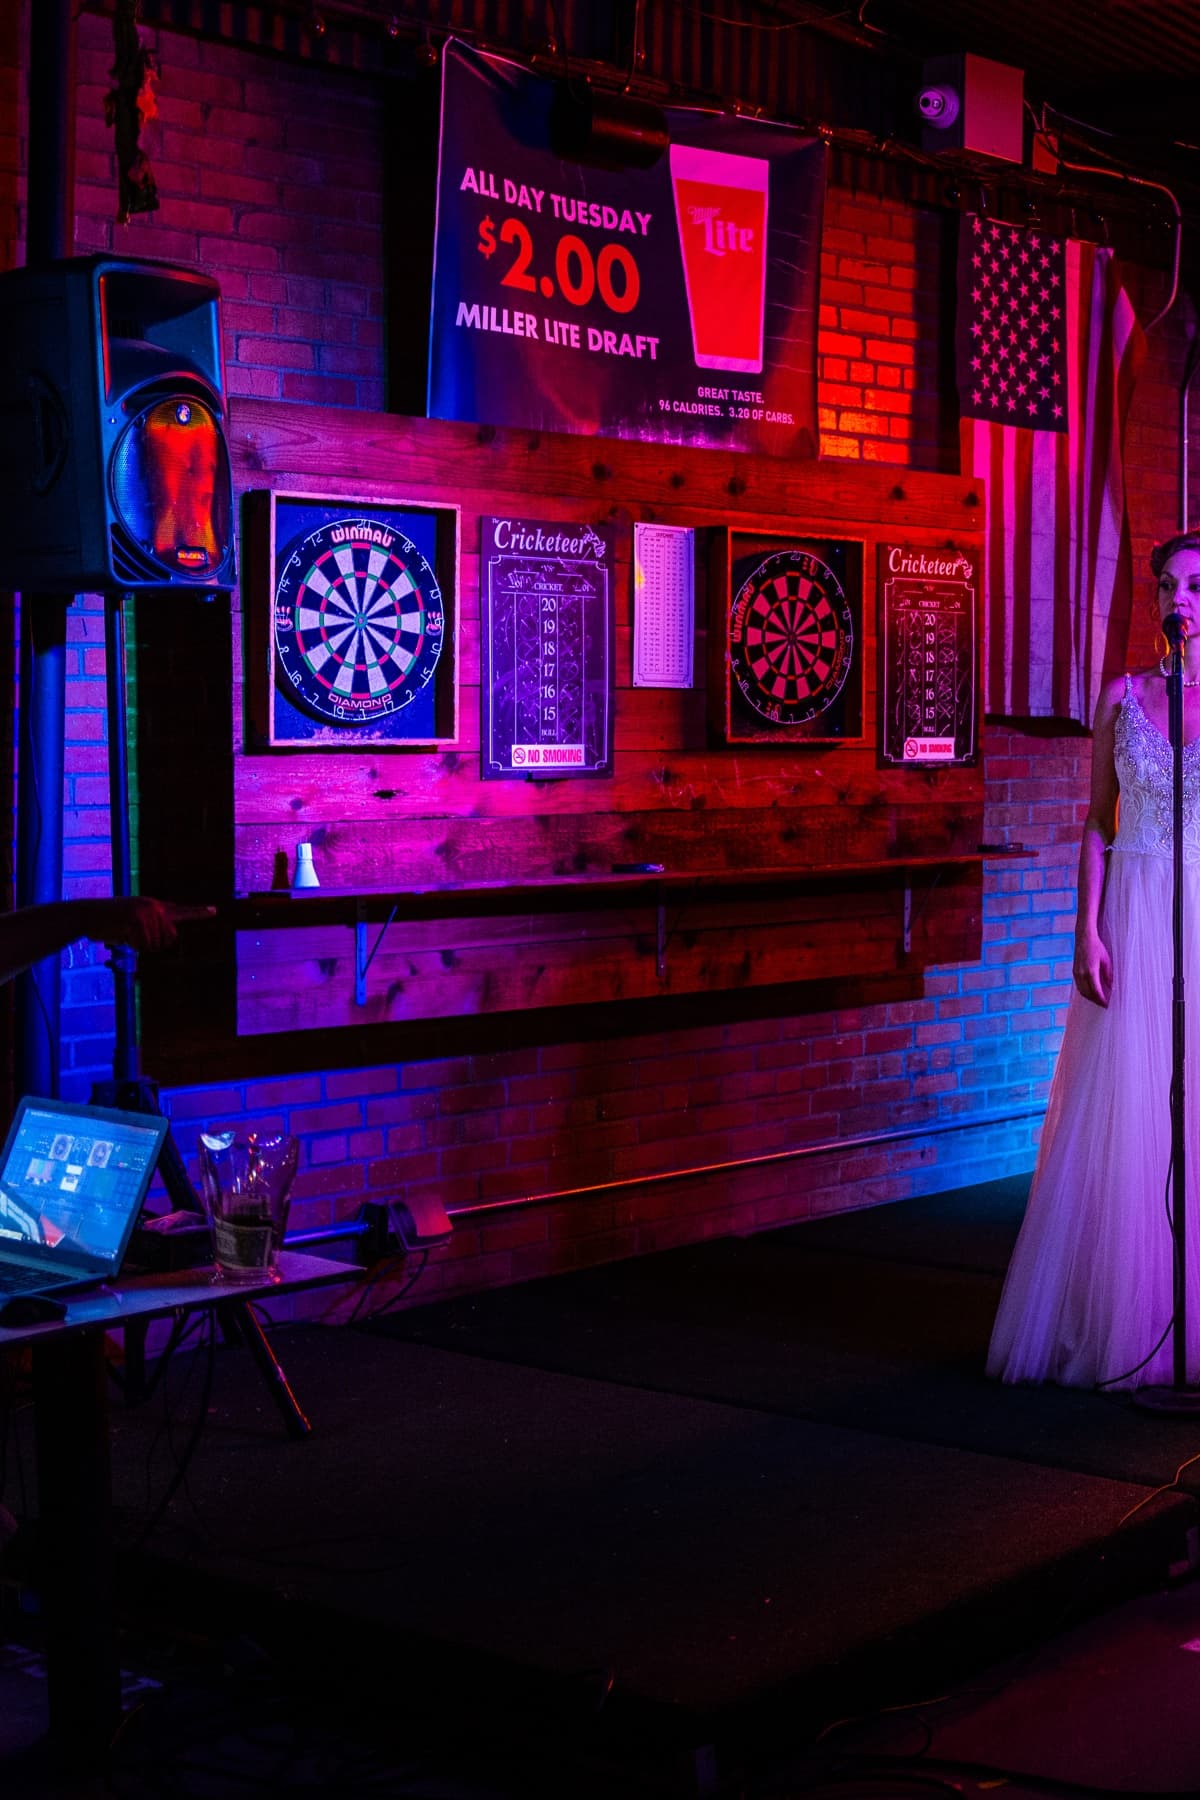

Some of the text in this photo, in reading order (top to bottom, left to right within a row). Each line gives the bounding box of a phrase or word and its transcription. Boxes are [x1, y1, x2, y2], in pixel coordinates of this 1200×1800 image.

[460, 167, 652, 237] ALL DAY TUESDAY
[702, 215, 755, 257] Lite
[477, 215, 640, 313] $2.00
[455, 301, 660, 360] MILLER LITE DRAFT
[697, 386, 765, 404] GREAT TASTE.
[659, 399, 670, 412] 96
[672, 401, 724, 417] CALORIES.
[751, 408, 764, 421] OF
[765, 410, 795, 425] CARBS.
[330, 526, 393, 548] WINMAU
[494, 520, 587, 555] Cricketeer
[888, 547, 960, 576] Cricketeer
[533, 582, 564, 592] CRICKET
[541, 598, 556, 612] 20
[925, 613, 936, 625] 20
[543, 619, 556, 634] 19
[925, 632, 935, 644] 19
[543, 641, 556, 655] 18
[925, 651, 935, 663] 18
[543, 663, 555, 677] 17
[925, 670, 935, 682] 17
[543, 684, 556, 698] 16
[925, 688, 935, 700] 16
[328, 692, 393, 711] DIAMOND
[543, 706, 556, 720] 15
[925, 707, 935, 719] 15
[528, 746, 583, 764] NO SMOKING
